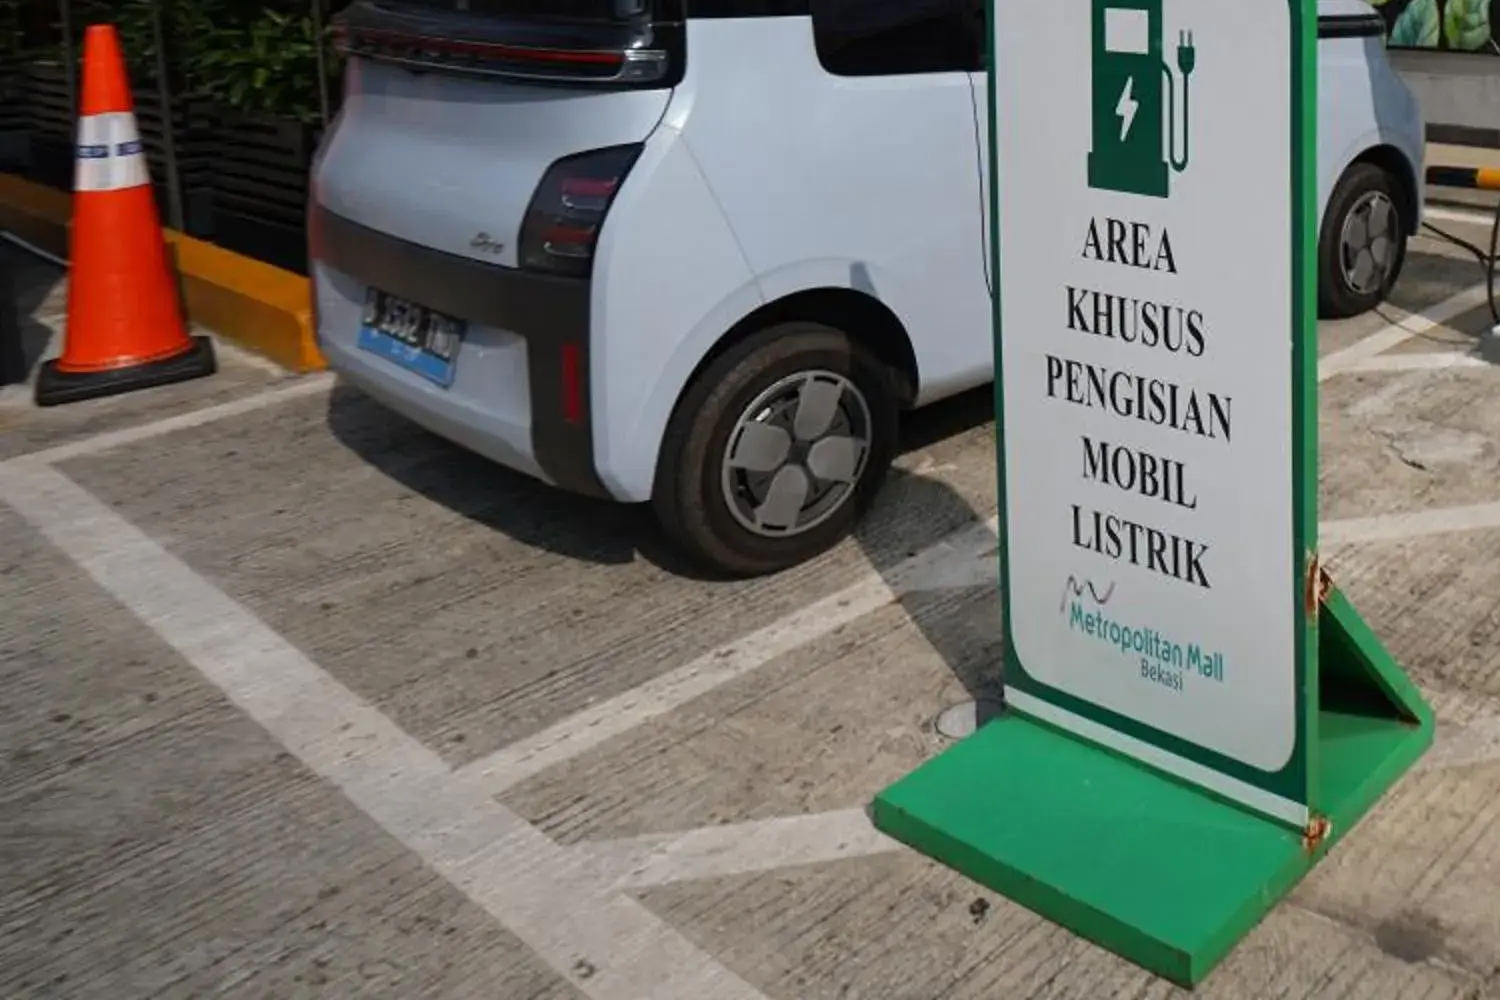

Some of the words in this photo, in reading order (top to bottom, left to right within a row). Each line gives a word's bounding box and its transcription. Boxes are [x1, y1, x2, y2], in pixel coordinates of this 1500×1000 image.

[1081, 216, 1178, 274] AREA
[1065, 285, 1206, 358] KHUSUS
[1045, 354, 1232, 442] PENGISIAN
[1081, 436, 1198, 510] MOBIL
[1071, 504, 1211, 589] LISTRIK
[1069, 601, 1183, 669] Metropolitan
[1186, 642, 1224, 683] Mall
[1140, 657, 1184, 691] Bekasi
